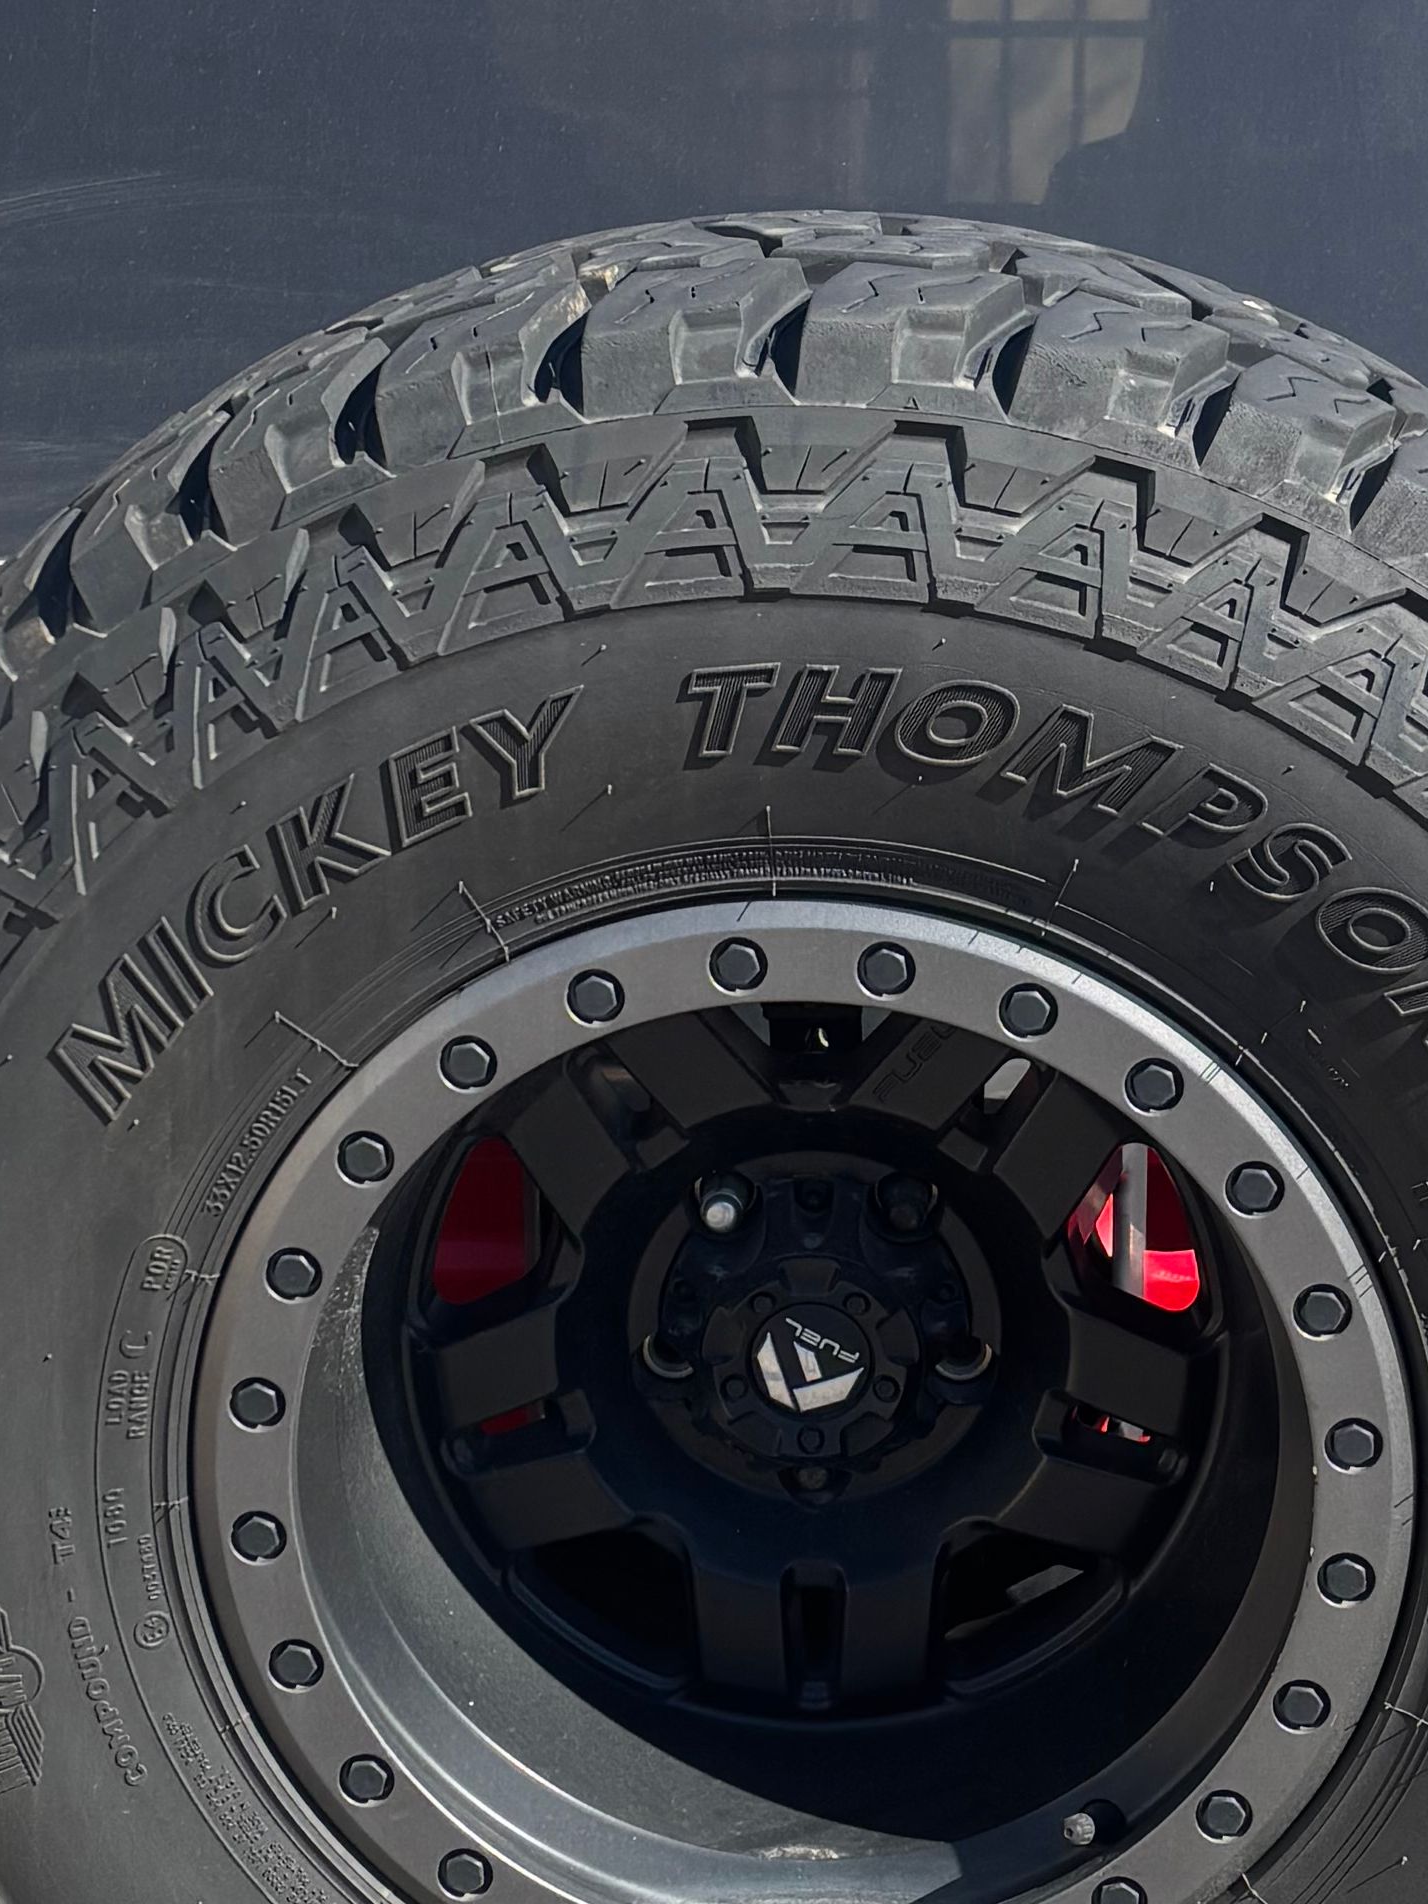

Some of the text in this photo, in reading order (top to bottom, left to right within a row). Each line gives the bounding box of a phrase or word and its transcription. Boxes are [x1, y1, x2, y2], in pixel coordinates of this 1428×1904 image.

[50, 684, 584, 1120] MICKEY
[785, 1317, 860, 1364] FUEL
[67, 1615, 148, 1786] COMPOUND
